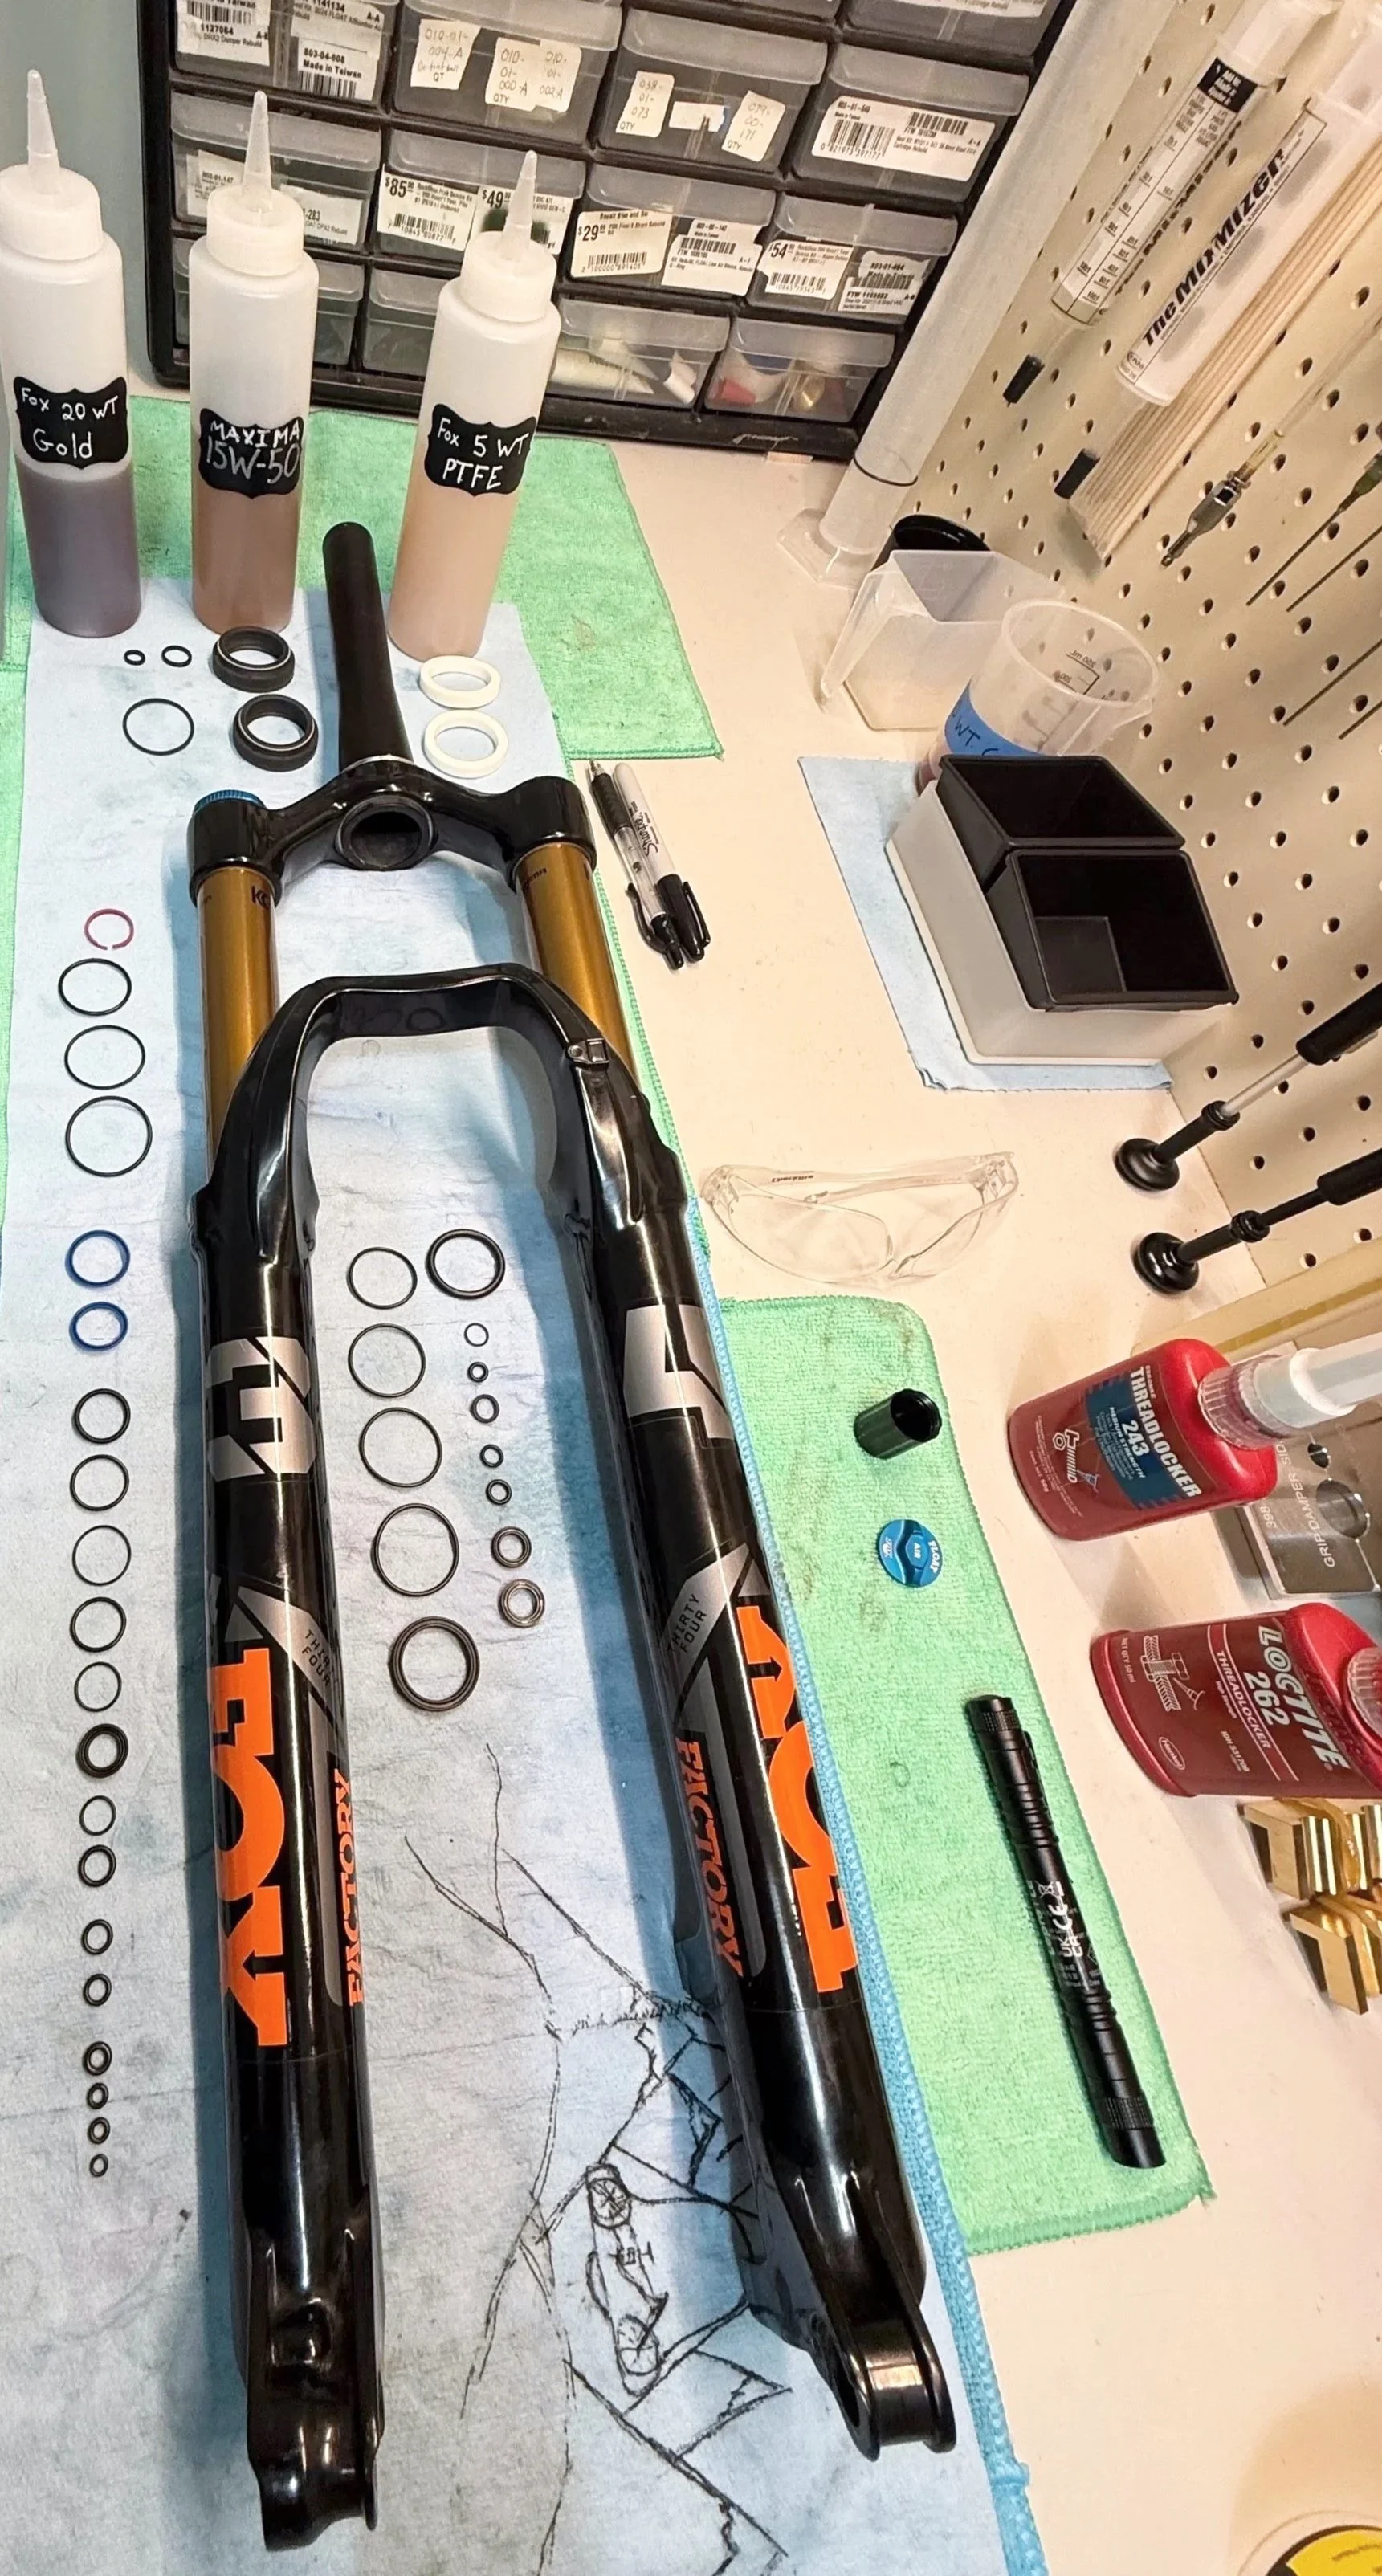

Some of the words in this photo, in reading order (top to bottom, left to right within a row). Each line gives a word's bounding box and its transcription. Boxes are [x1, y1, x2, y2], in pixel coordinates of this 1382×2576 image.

[303, 59, 324, 71] Made
[325, 64, 332, 73] in
[334, 65, 362, 79] Taiwan
[1142, 300, 1177, 347] The
[21, 387, 50, 413] Fox
[61, 402, 87, 422] 20
[92, 395, 119, 420] WT
[33, 427, 93, 459] Gold
[210, 418, 300, 449] MAXIMA
[437, 417, 460, 447] Fox
[472, 434, 488, 458] 5
[496, 432, 530, 458] WT
[206, 434, 300, 485] 15W-50
[442, 457, 503, 491] PTFE
[1109, 1406, 1124, 1438] MEDIUM
[1119, 1437, 1147, 1478] STRENGTH
[1121, 1420, 1150, 1457] 243
[1130, 1365, 1203, 1498] THREADLOCKER
[1275, 1441, 1292, 1466] SID
[1287, 1472, 1321, 1531] DAMPER
[913, 1541, 922, 1559] AIR
[927, 1540, 940, 1574] FLOAT
[1314, 1535, 1335, 1568] GRIP
[679, 1609, 707, 1653] FOUR
[301, 1645, 331, 1687] FOUR
[1216, 1650, 1273, 1750] THREADLOCKER
[1242, 1671, 1291, 1726] 262
[1258, 1624, 1352, 1770] LOCTITE
[675, 1736, 744, 1978] FACTORY
[333, 1767, 365, 2008] FACTORY
